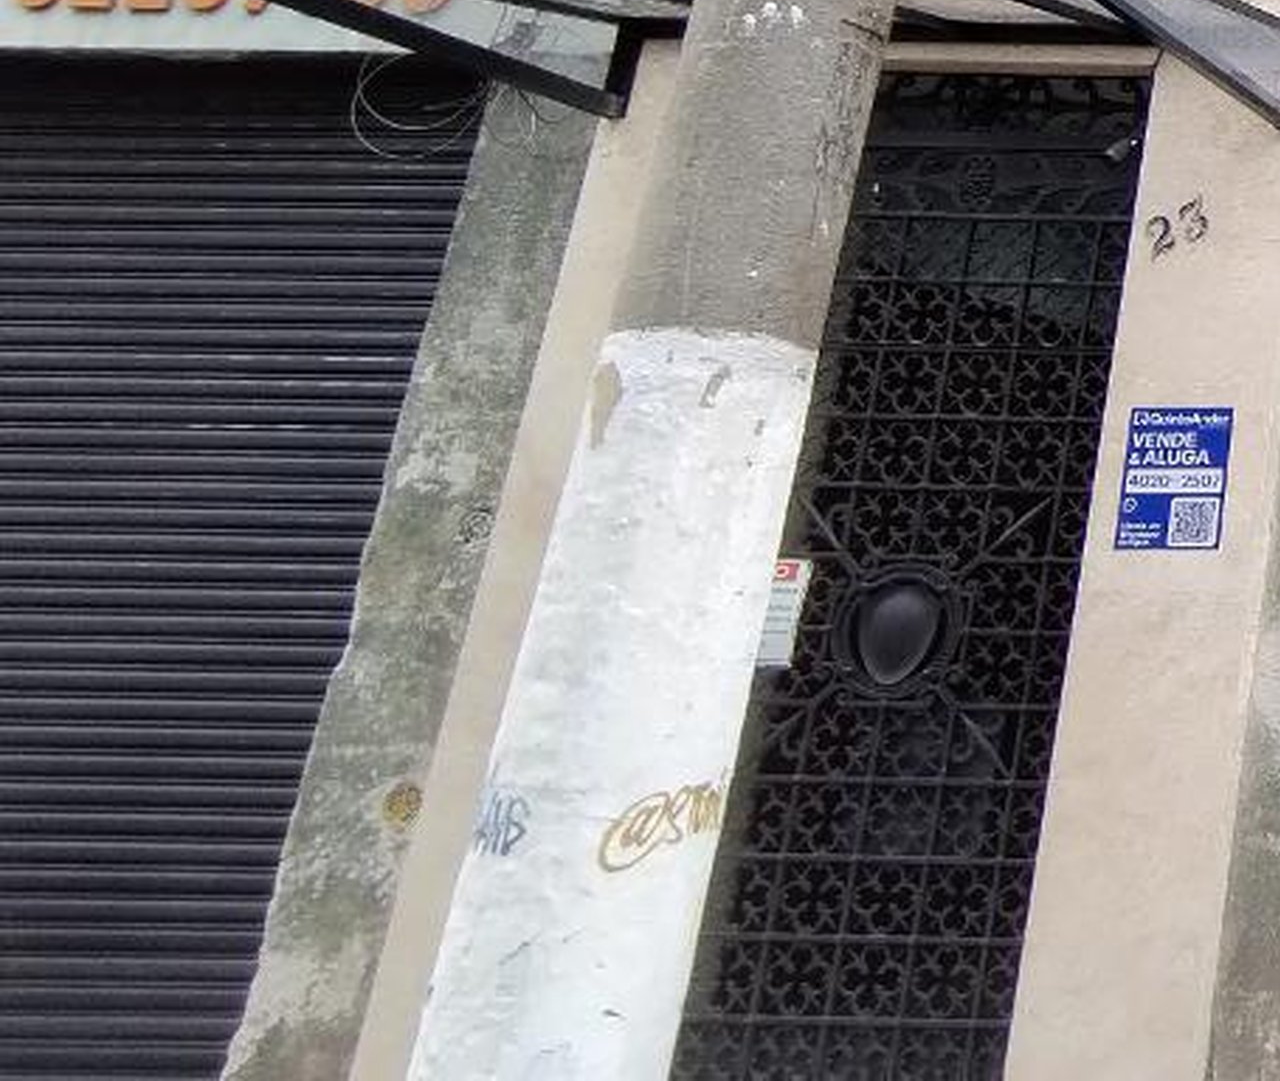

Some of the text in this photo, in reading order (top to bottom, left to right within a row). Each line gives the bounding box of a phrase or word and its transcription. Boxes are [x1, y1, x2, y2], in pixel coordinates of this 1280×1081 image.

[1146, 195, 1209, 261] 23
[1133, 432, 1198, 448] VENDE
[1128, 450, 1210, 466] & ALUGA
